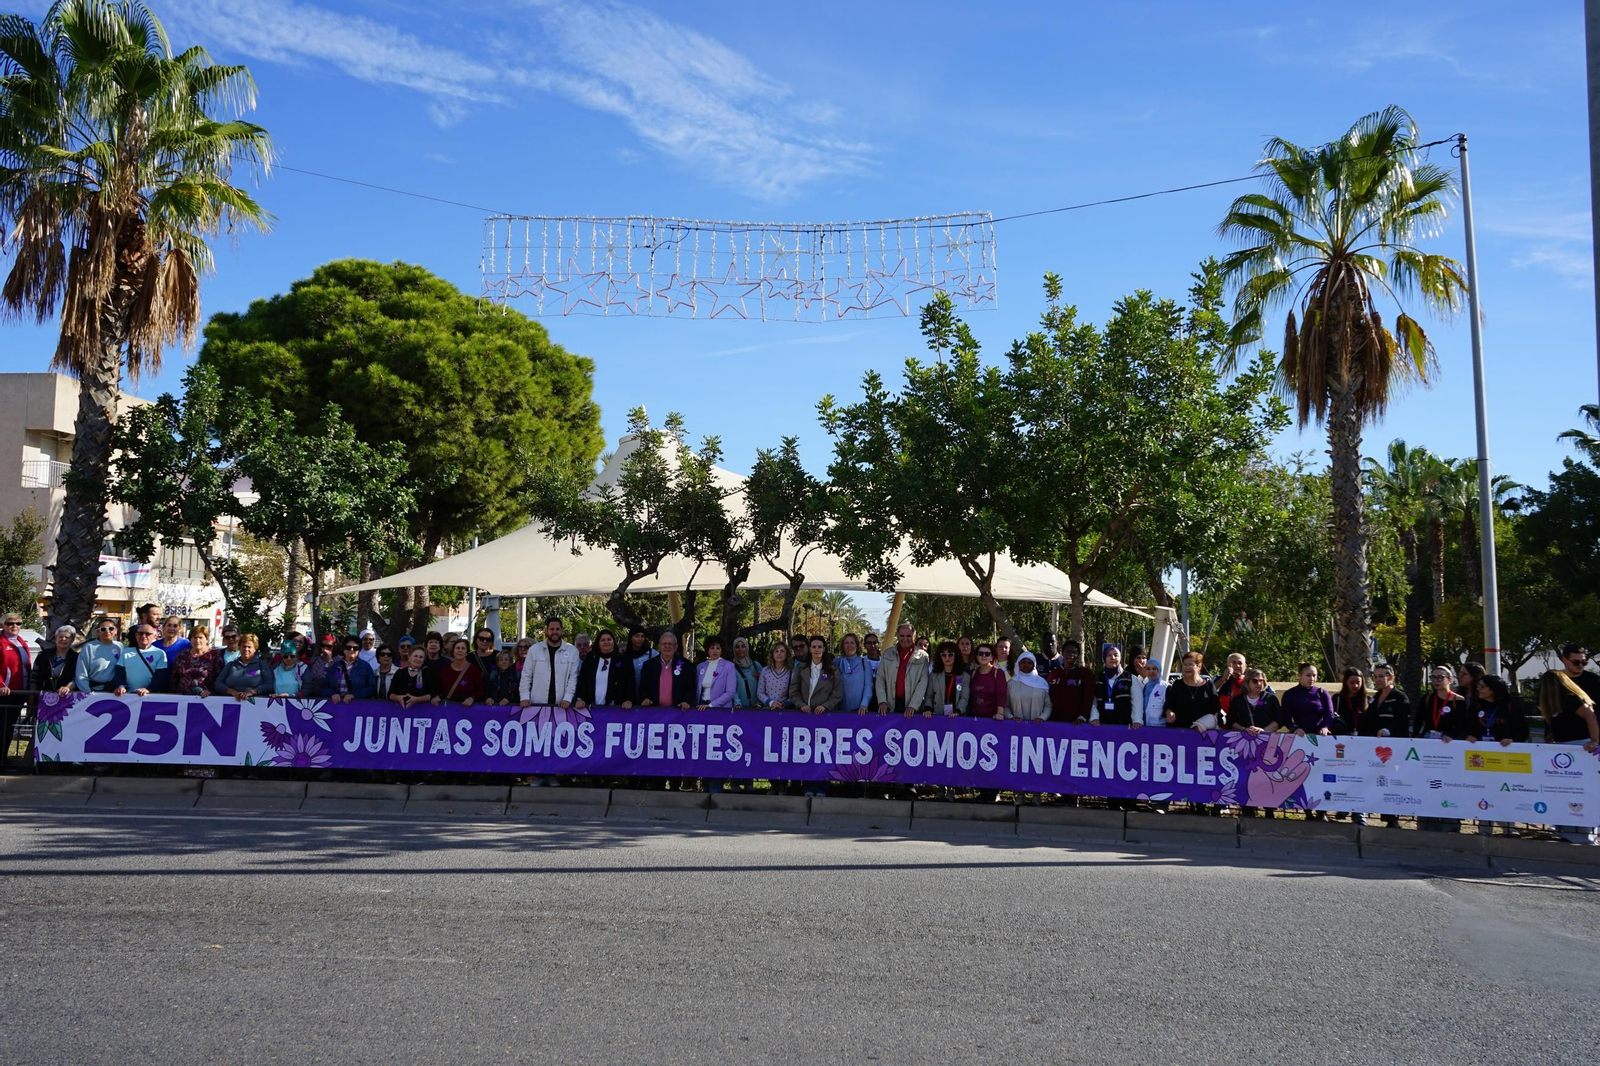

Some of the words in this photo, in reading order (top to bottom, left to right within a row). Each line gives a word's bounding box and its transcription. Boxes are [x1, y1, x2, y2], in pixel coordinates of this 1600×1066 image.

[83, 698, 241, 757] 25N
[343, 716, 473, 754] JUNTAS
[481, 719, 595, 758] SOMOS
[604, 722, 751, 767] FUERTES,
[763, 726, 873, 765] LIBRES
[883, 728, 999, 771] SOMOS
[1009, 735, 1239, 786] INVENCIBLES
